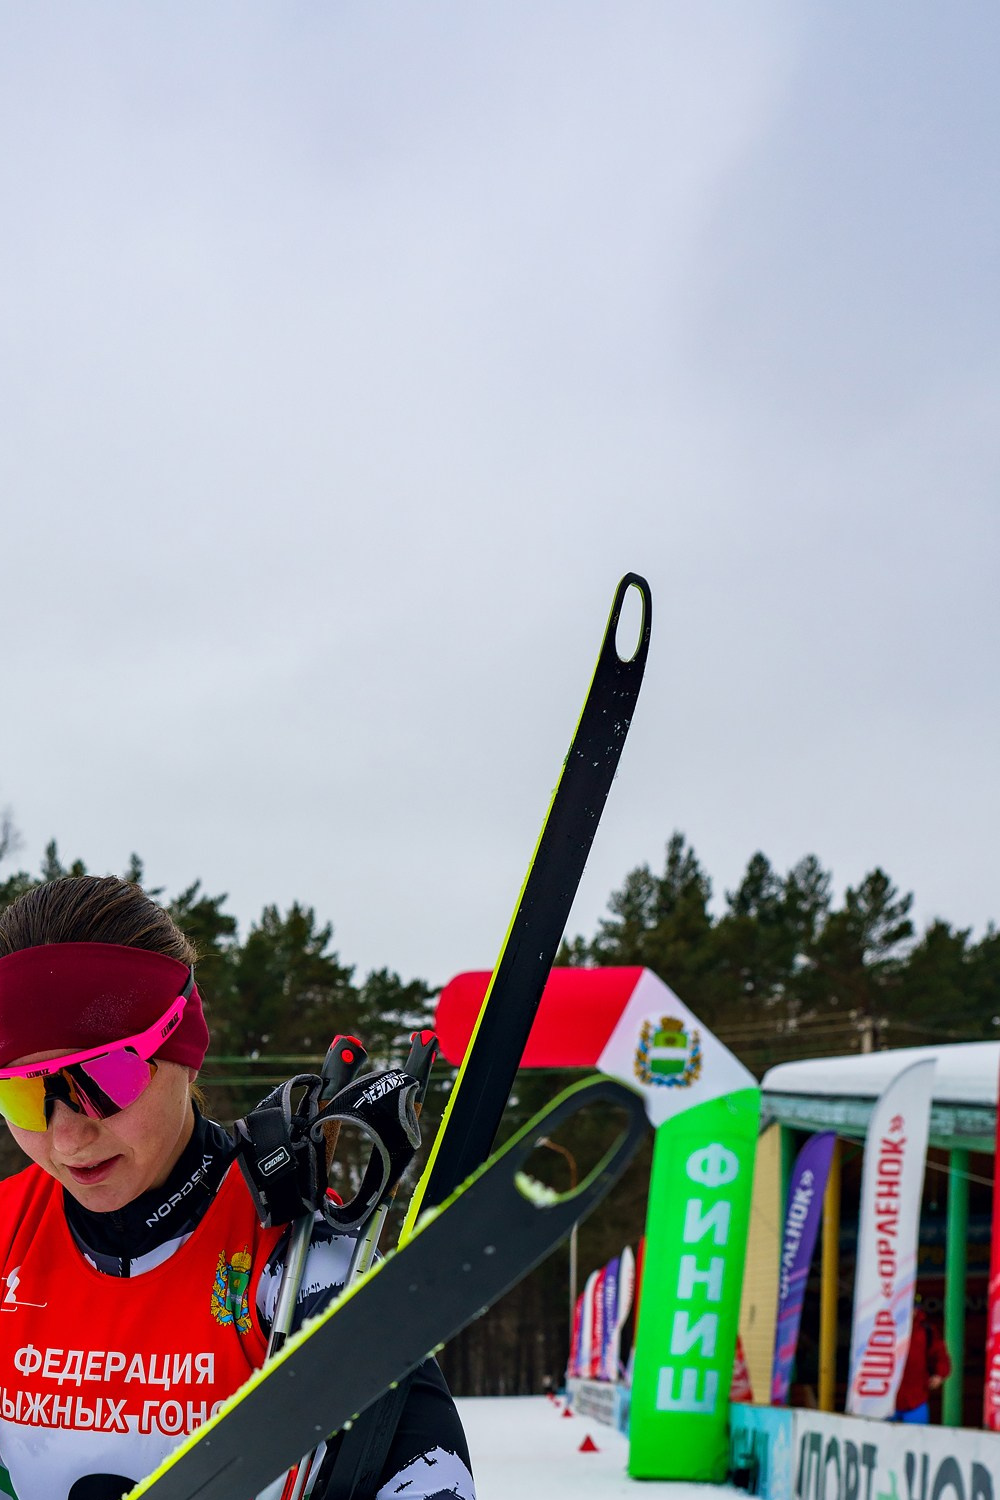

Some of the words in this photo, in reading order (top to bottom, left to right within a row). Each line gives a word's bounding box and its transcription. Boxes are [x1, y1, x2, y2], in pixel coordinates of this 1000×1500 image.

[145, 1154, 214, 1228] NORDSKI
[875, 1114, 907, 1299] «ОРЛЕНОК»
[656, 1142, 739, 1414] ФИНИШ
[13, 1344, 215, 1391] ФЕДЕРАЦИЯ
[858, 1309, 898, 1398] СШОР
